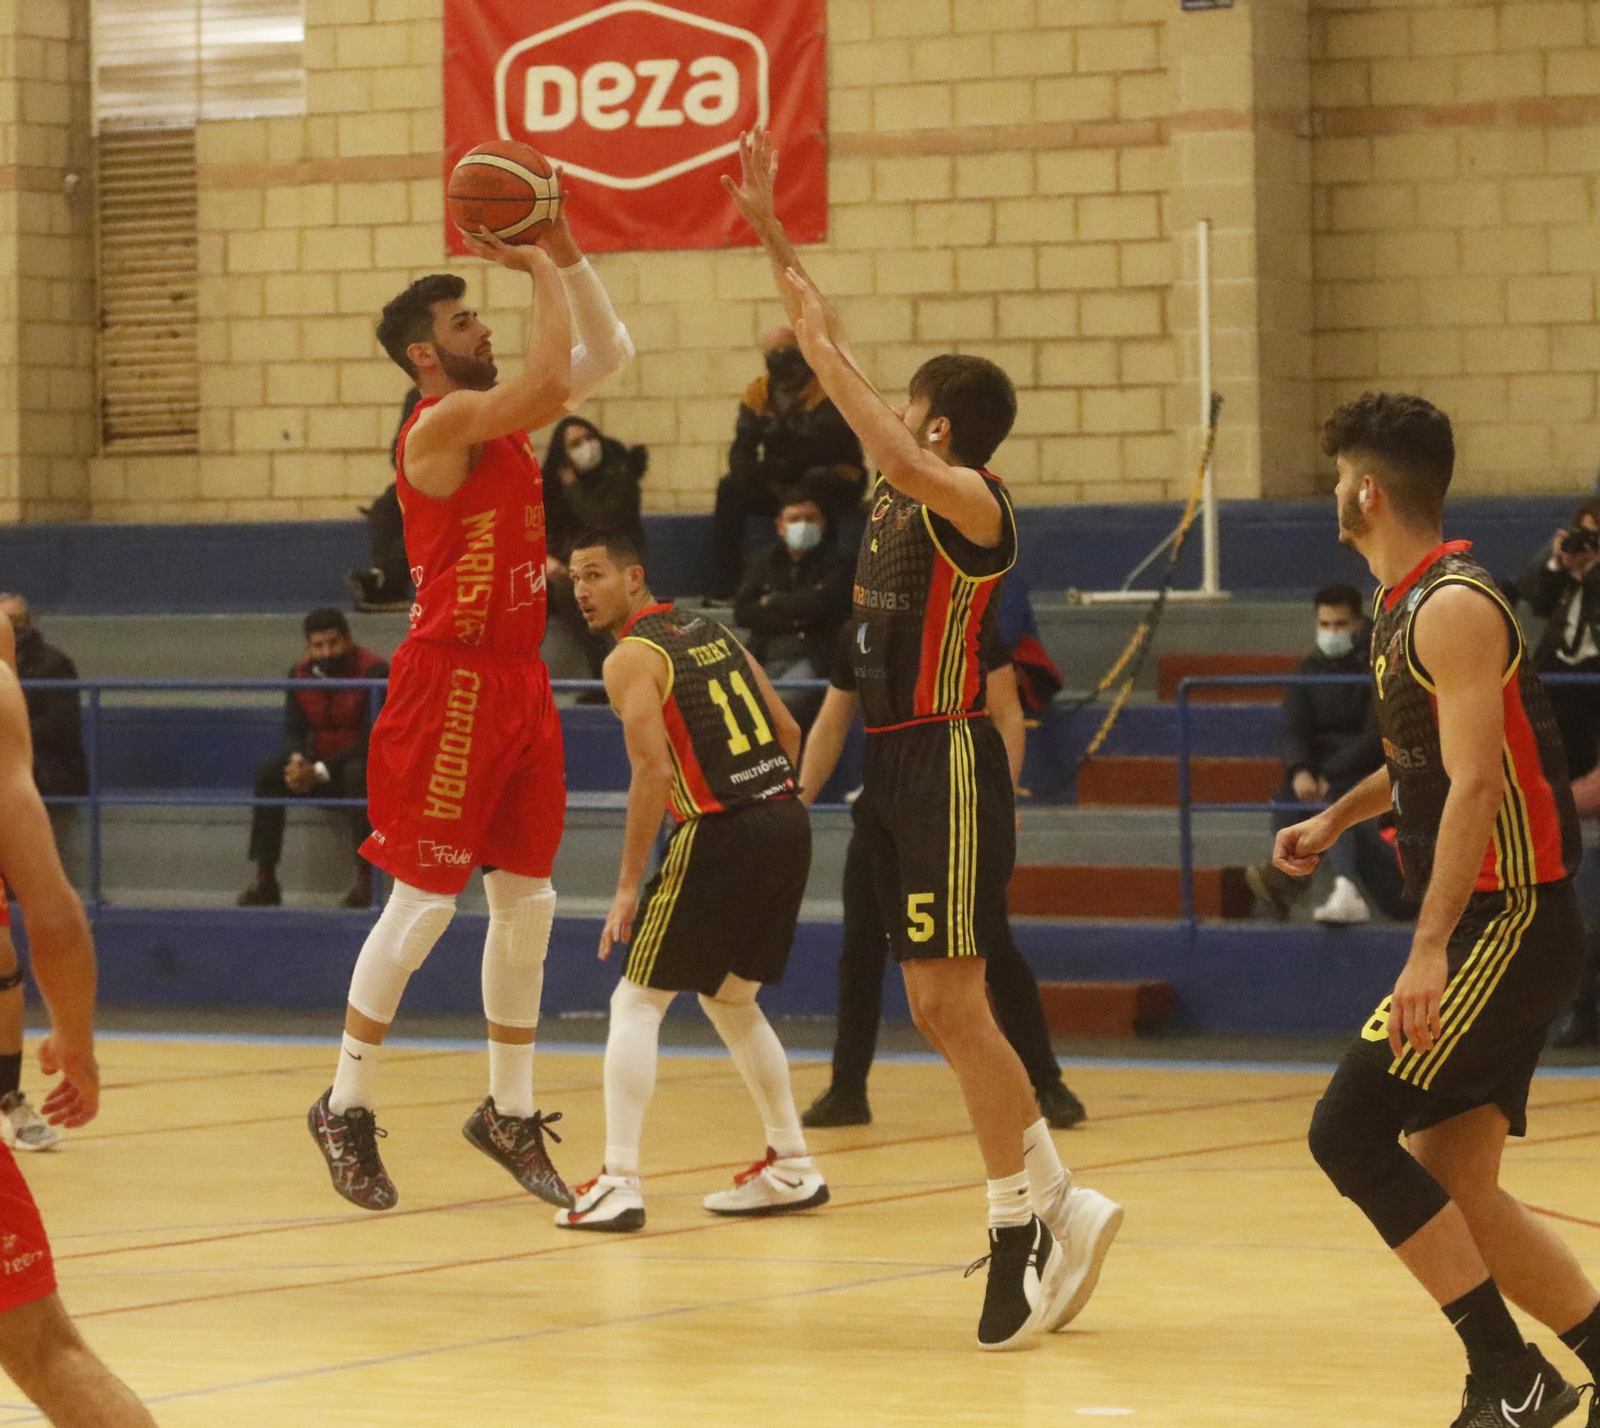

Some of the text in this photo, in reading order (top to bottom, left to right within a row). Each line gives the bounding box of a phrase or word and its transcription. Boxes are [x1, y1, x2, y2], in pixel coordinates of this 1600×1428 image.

[524, 55, 740, 132] Deza
[687, 638, 732, 667] TERRY
[422, 668, 481, 820] CORDOBA
[708, 670, 774, 756] 11
[907, 892, 935, 943] 5
